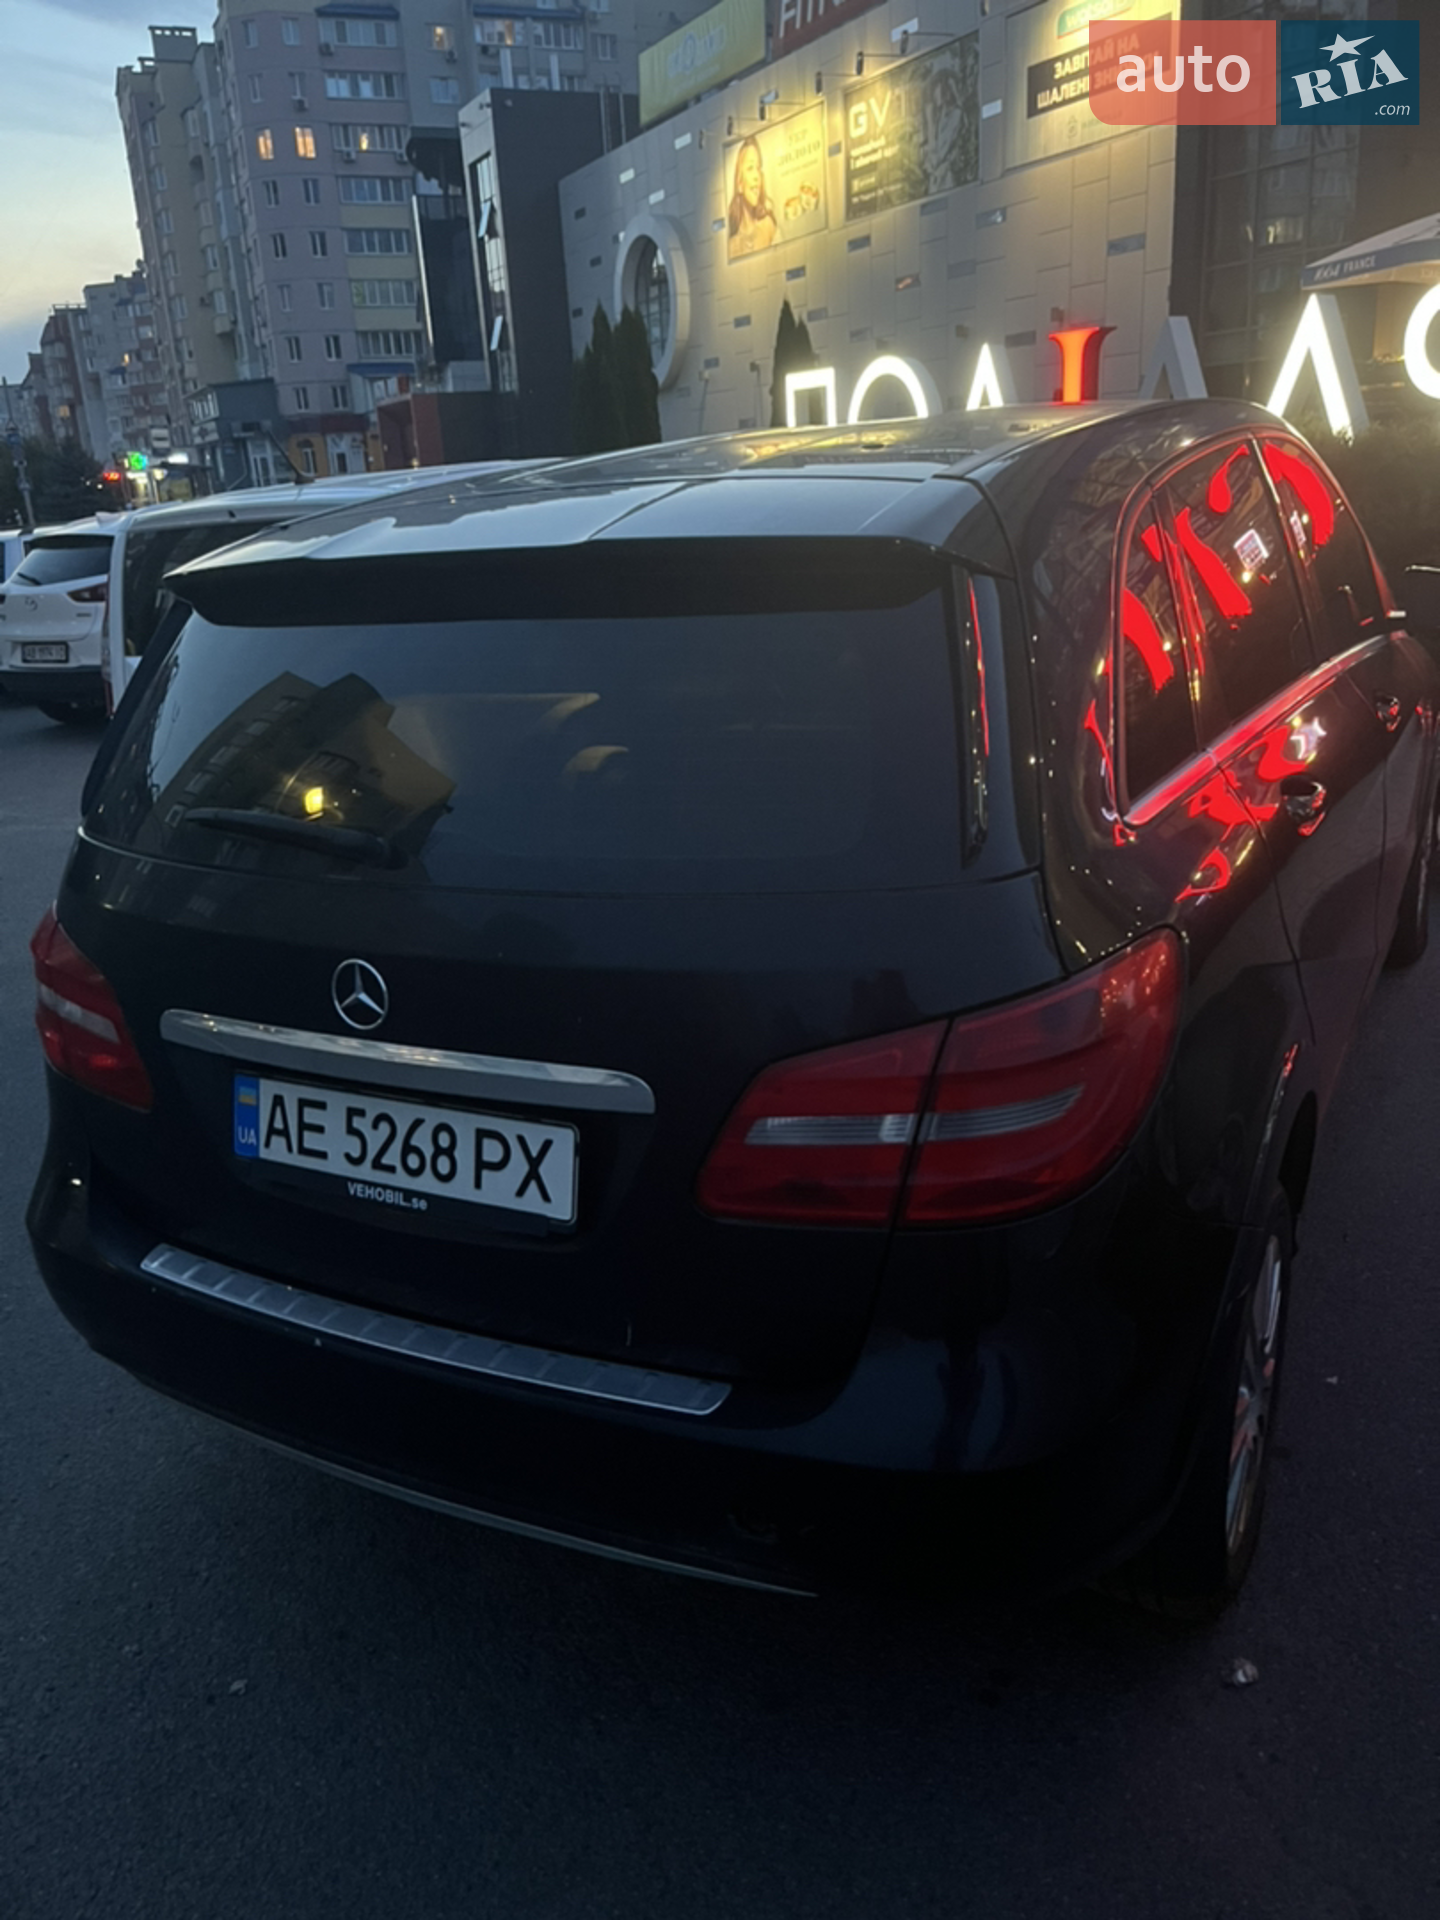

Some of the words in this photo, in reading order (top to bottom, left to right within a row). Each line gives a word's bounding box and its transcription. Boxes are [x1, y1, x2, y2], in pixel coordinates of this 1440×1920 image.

[1054, 38, 1114, 79] ЗАВІТАЙ
[1117, 32, 1140, 56] НА
[1344, 255, 1376, 273] FRANCE
[238, 1127, 258, 1147] UA
[264, 1094, 328, 1160] AE
[343, 1107, 458, 1183] 5268
[474, 1128, 554, 1204] PX
[347, 1182, 427, 1211] VEHOBIL.se
